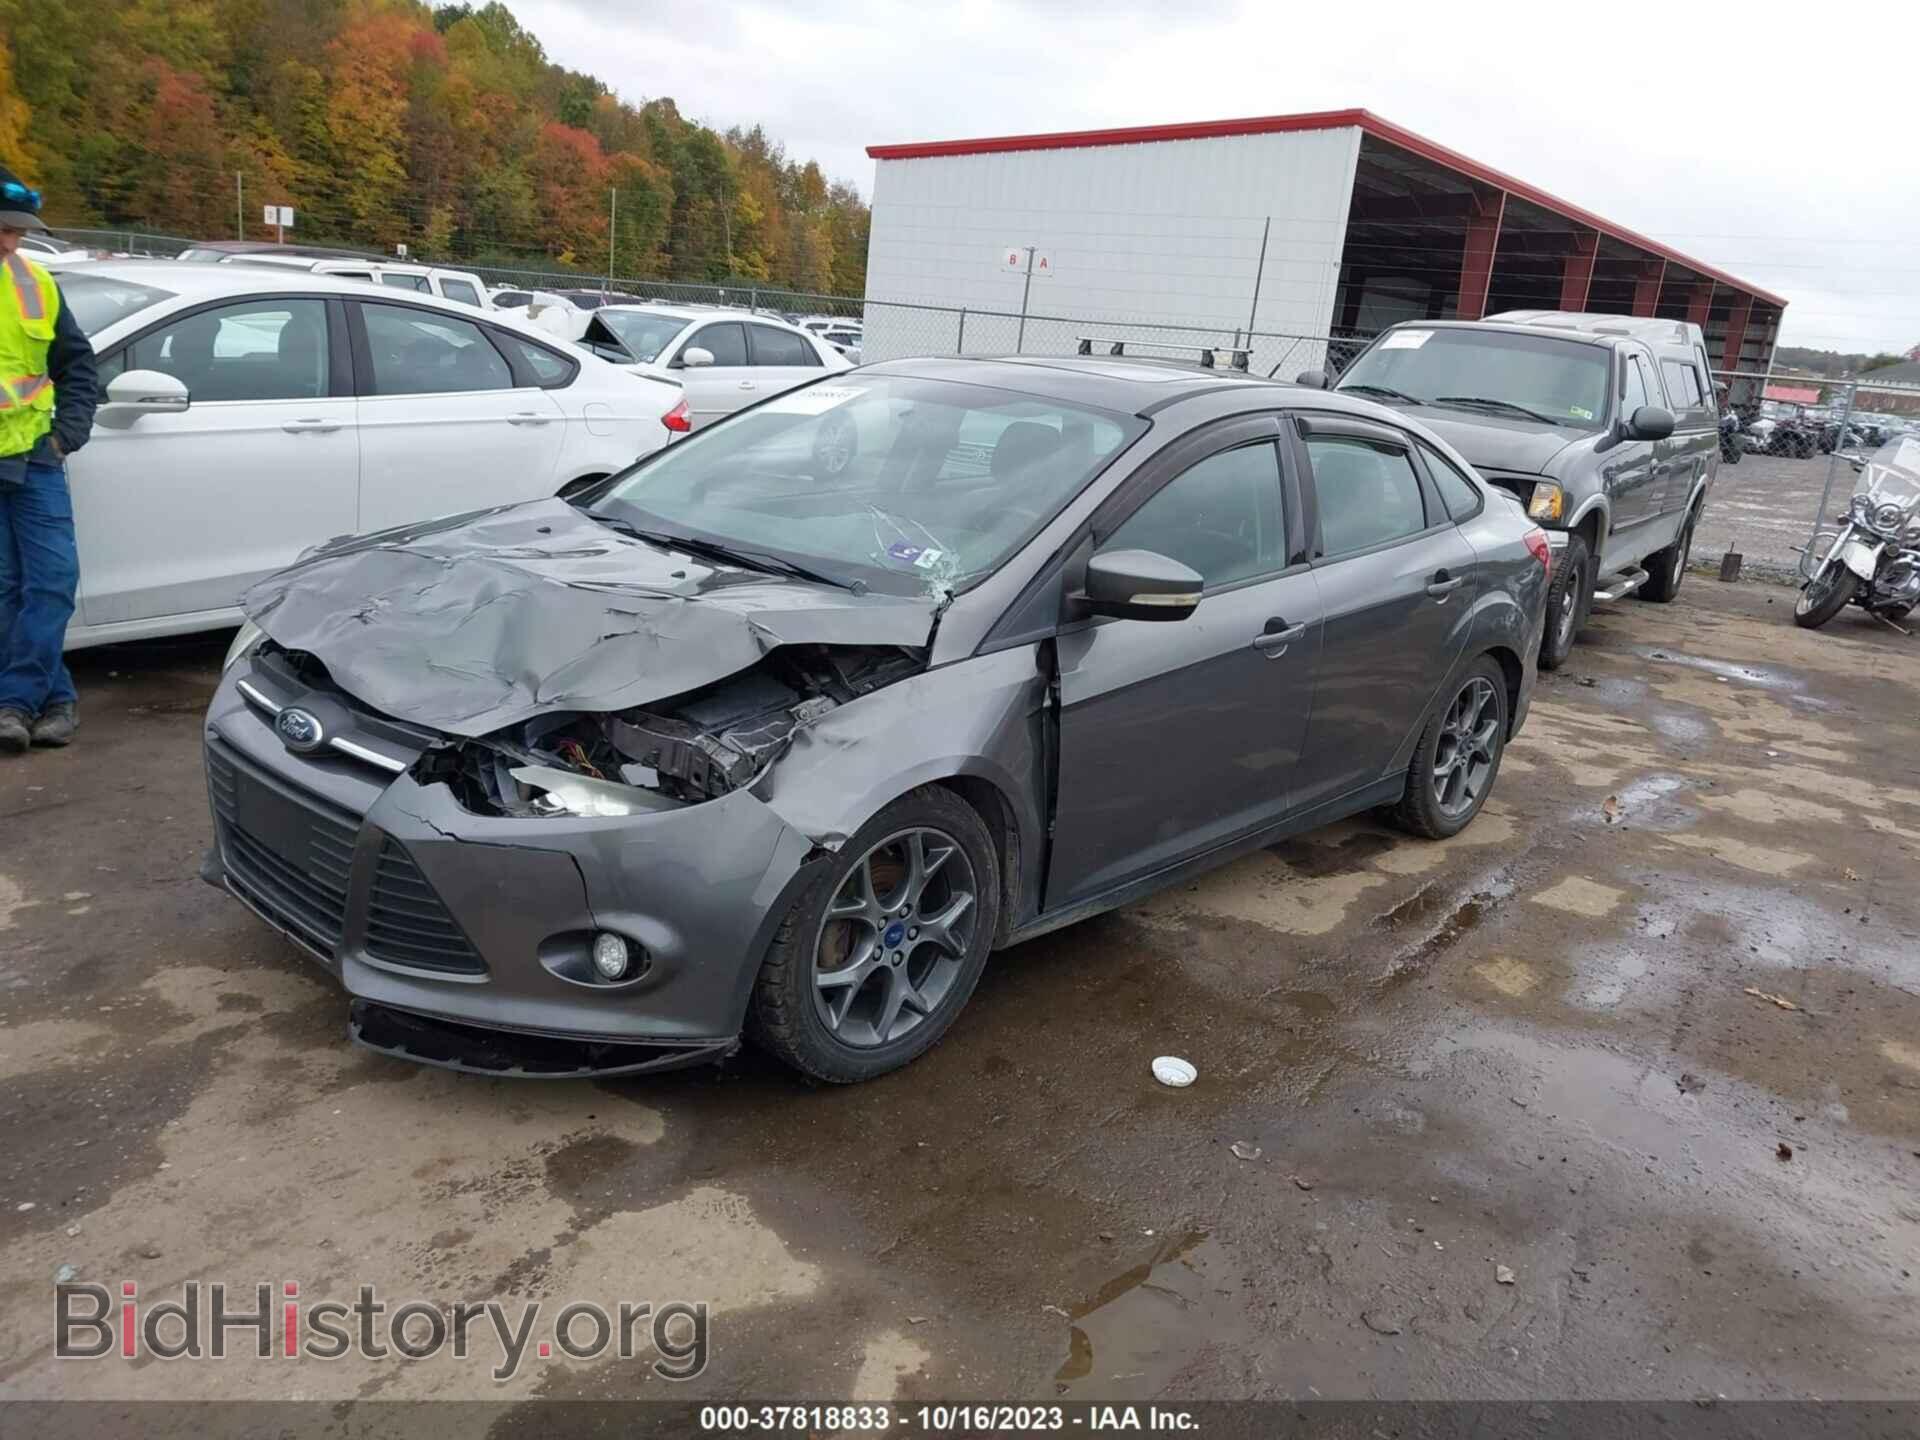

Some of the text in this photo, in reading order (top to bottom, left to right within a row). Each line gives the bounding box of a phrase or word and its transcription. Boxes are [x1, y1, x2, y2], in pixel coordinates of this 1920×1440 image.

[1009, 254, 1017, 265] B
[1040, 257, 1048, 269] A
[281, 713, 310, 739] Ford
